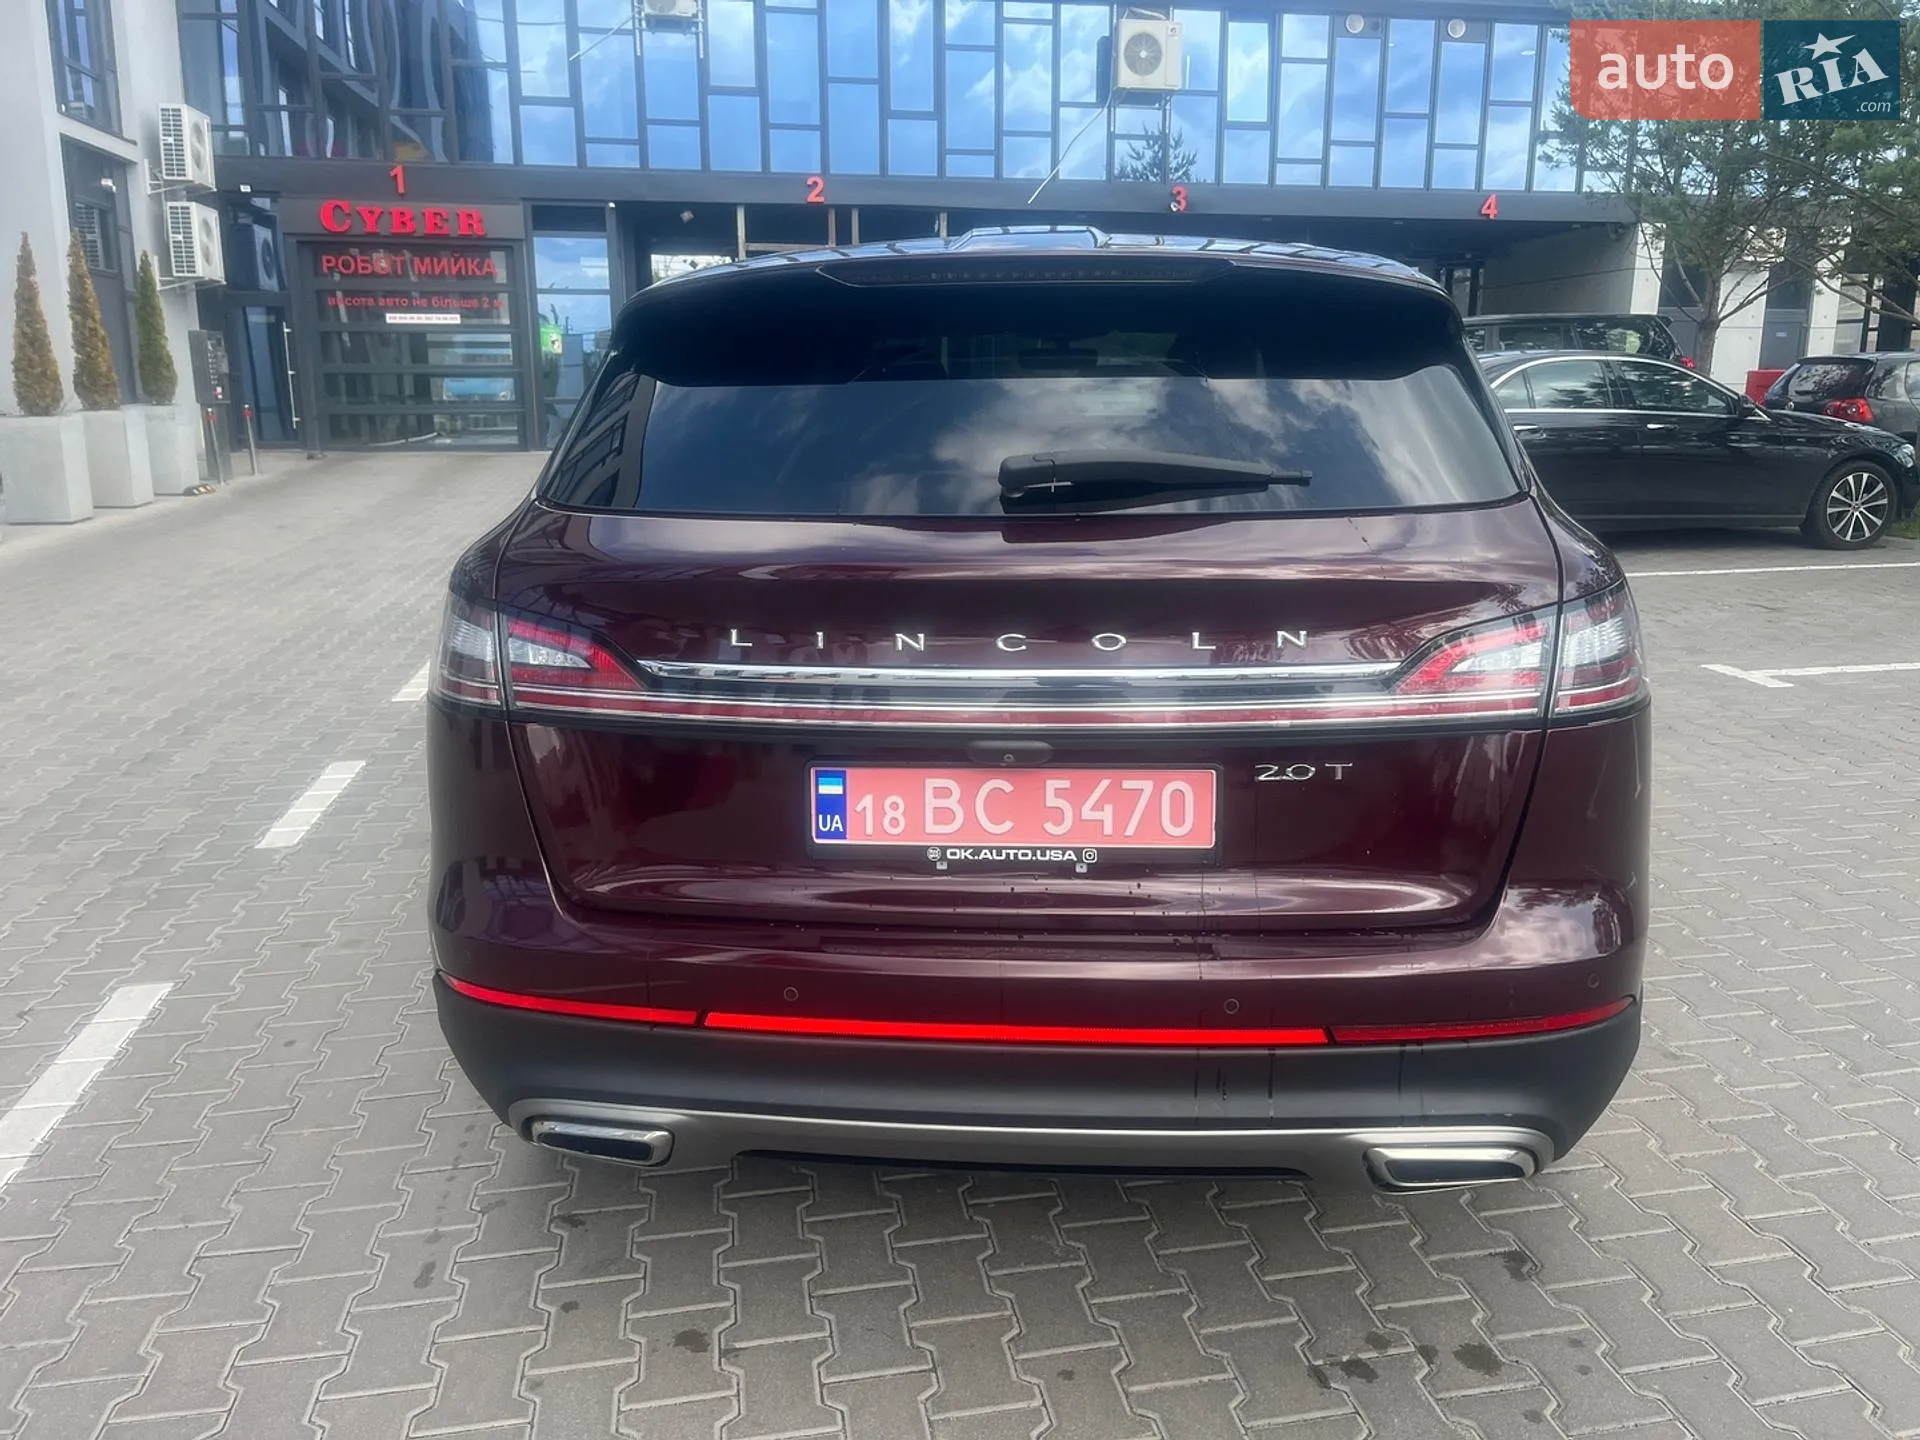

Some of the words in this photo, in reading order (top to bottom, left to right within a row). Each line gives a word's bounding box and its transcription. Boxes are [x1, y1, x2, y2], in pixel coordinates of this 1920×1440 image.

[390, 164, 405, 194] 1
[806, 176, 825, 203] 2
[1170, 186, 1187, 212] 3
[1481, 194, 1498, 220] 4
[321, 255, 405, 275] РОБОТ
[414, 253, 497, 276] МИЙКА
[379, 297, 409, 308] авто
[412, 298, 428, 308] не
[432, 296, 479, 309] більше
[483, 297, 490, 308] 2
[730, 628, 1309, 652] LINCOLN
[853, 793, 907, 834] 18
[922, 777, 1015, 834] BC
[1041, 779, 1196, 837] 5470
[818, 814, 844, 832] UA
[946, 848, 1077, 862] OK.AUTO.USA
